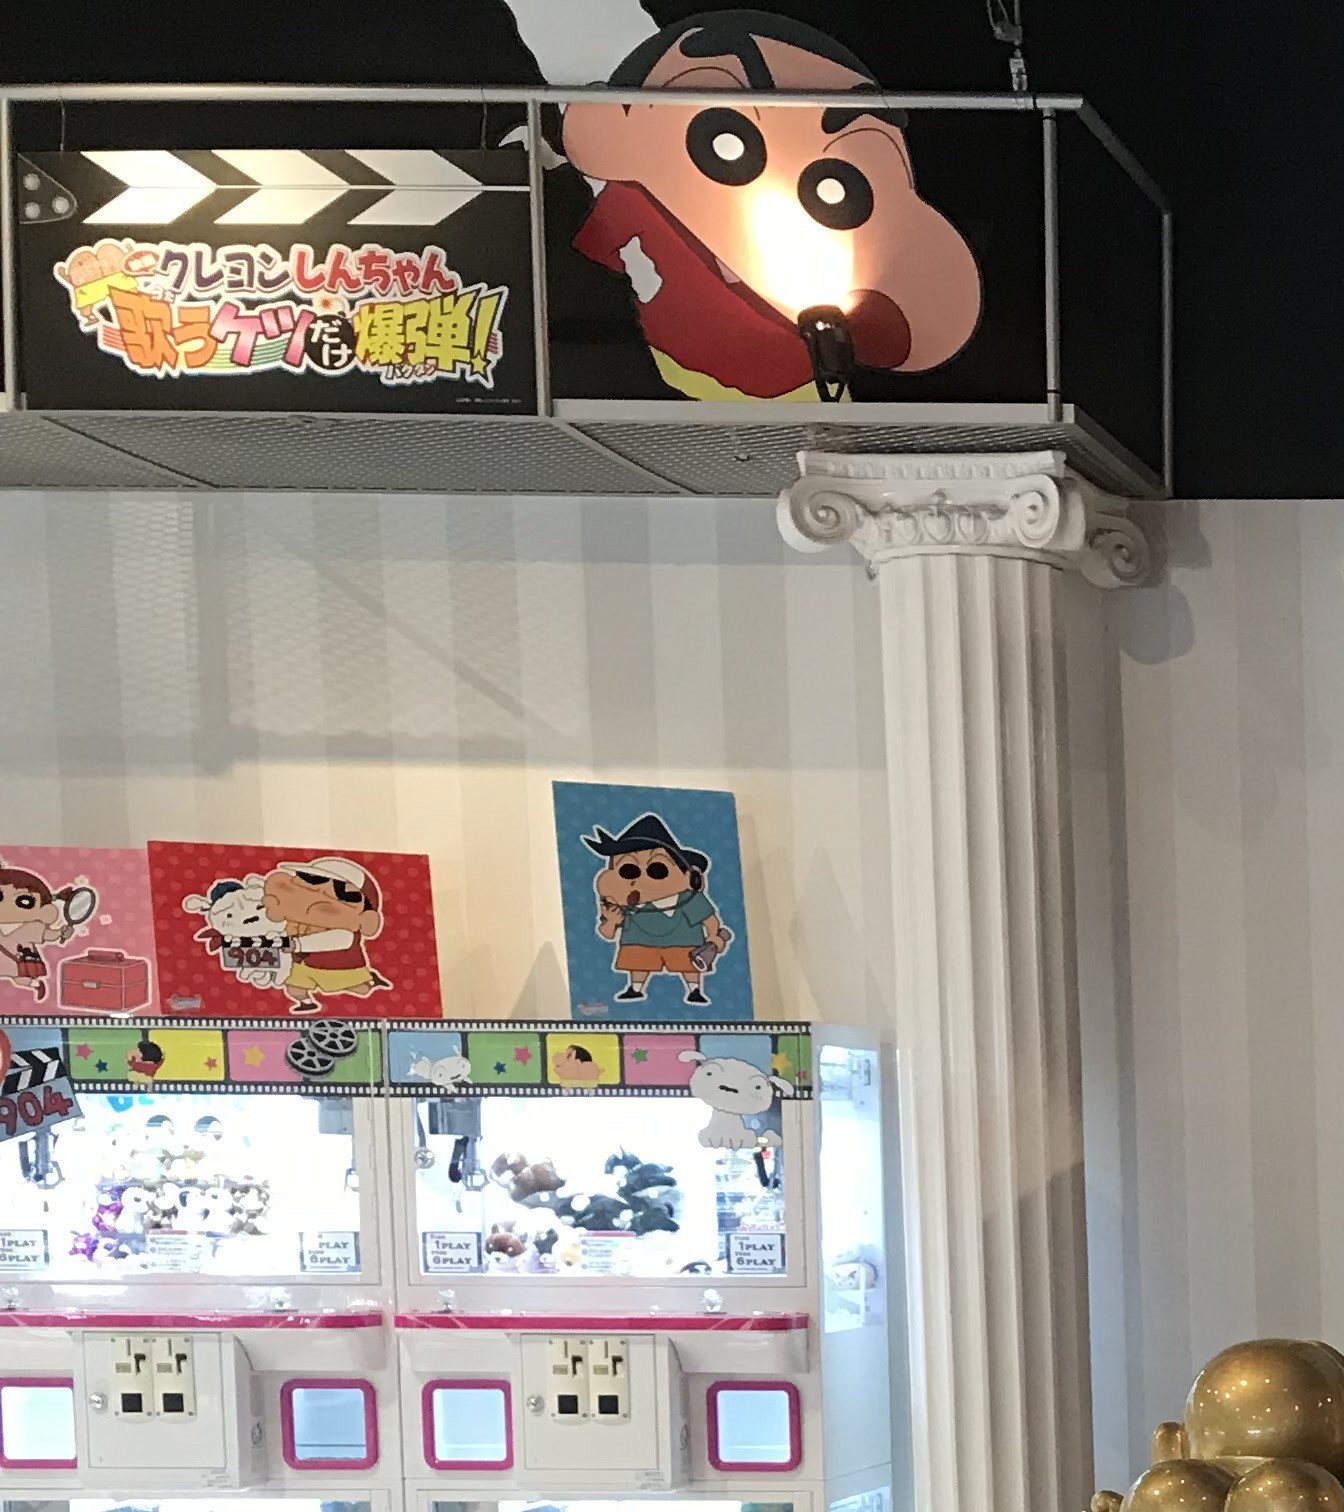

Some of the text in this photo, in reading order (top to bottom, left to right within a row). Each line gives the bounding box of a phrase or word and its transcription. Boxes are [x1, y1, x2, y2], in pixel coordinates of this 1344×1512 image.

[160, 248, 456, 296] クレヨンしんちゃん
[227, 947, 278, 968] 904
[0, 1085, 73, 1136] 904
